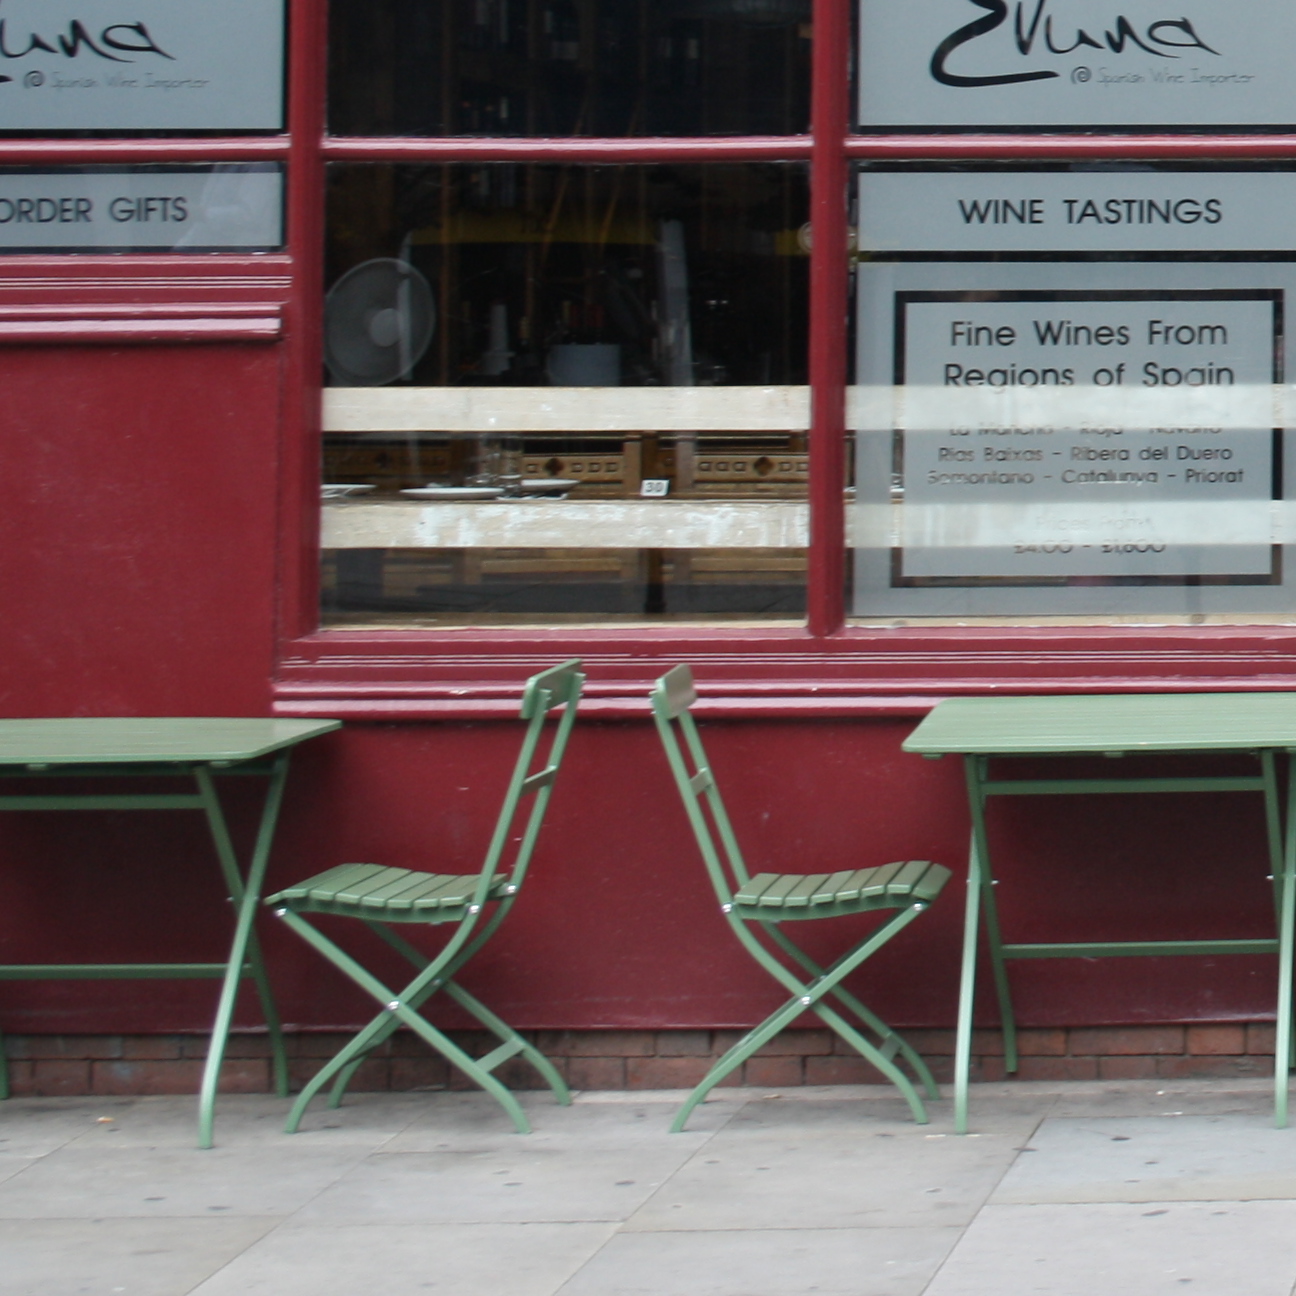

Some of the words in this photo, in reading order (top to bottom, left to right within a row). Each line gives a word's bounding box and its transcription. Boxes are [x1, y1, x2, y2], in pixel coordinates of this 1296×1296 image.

[1096, 67, 1146, 88] Spanish
[108, 196, 188, 222] GIFTS
[957, 199, 1044, 224] WINE
[1063, 198, 1223, 224] TASTINGS
[951, 320, 1016, 346] Fine
[1032, 319, 1130, 346] Wines
[1147, 319, 1228, 345] From
[944, 363, 1075, 389] Regions
[1093, 362, 1126, 386] of
[1142, 361, 1234, 386] Spain
[1070, 446, 1130, 462] Ribera
[1138, 445, 1169, 461] del
[1176, 446, 1233, 461] Duero
[645, 480, 664, 494] 30
[1061, 469, 1159, 487] Catalunya
[1185, 468, 1245, 484] Priorat
